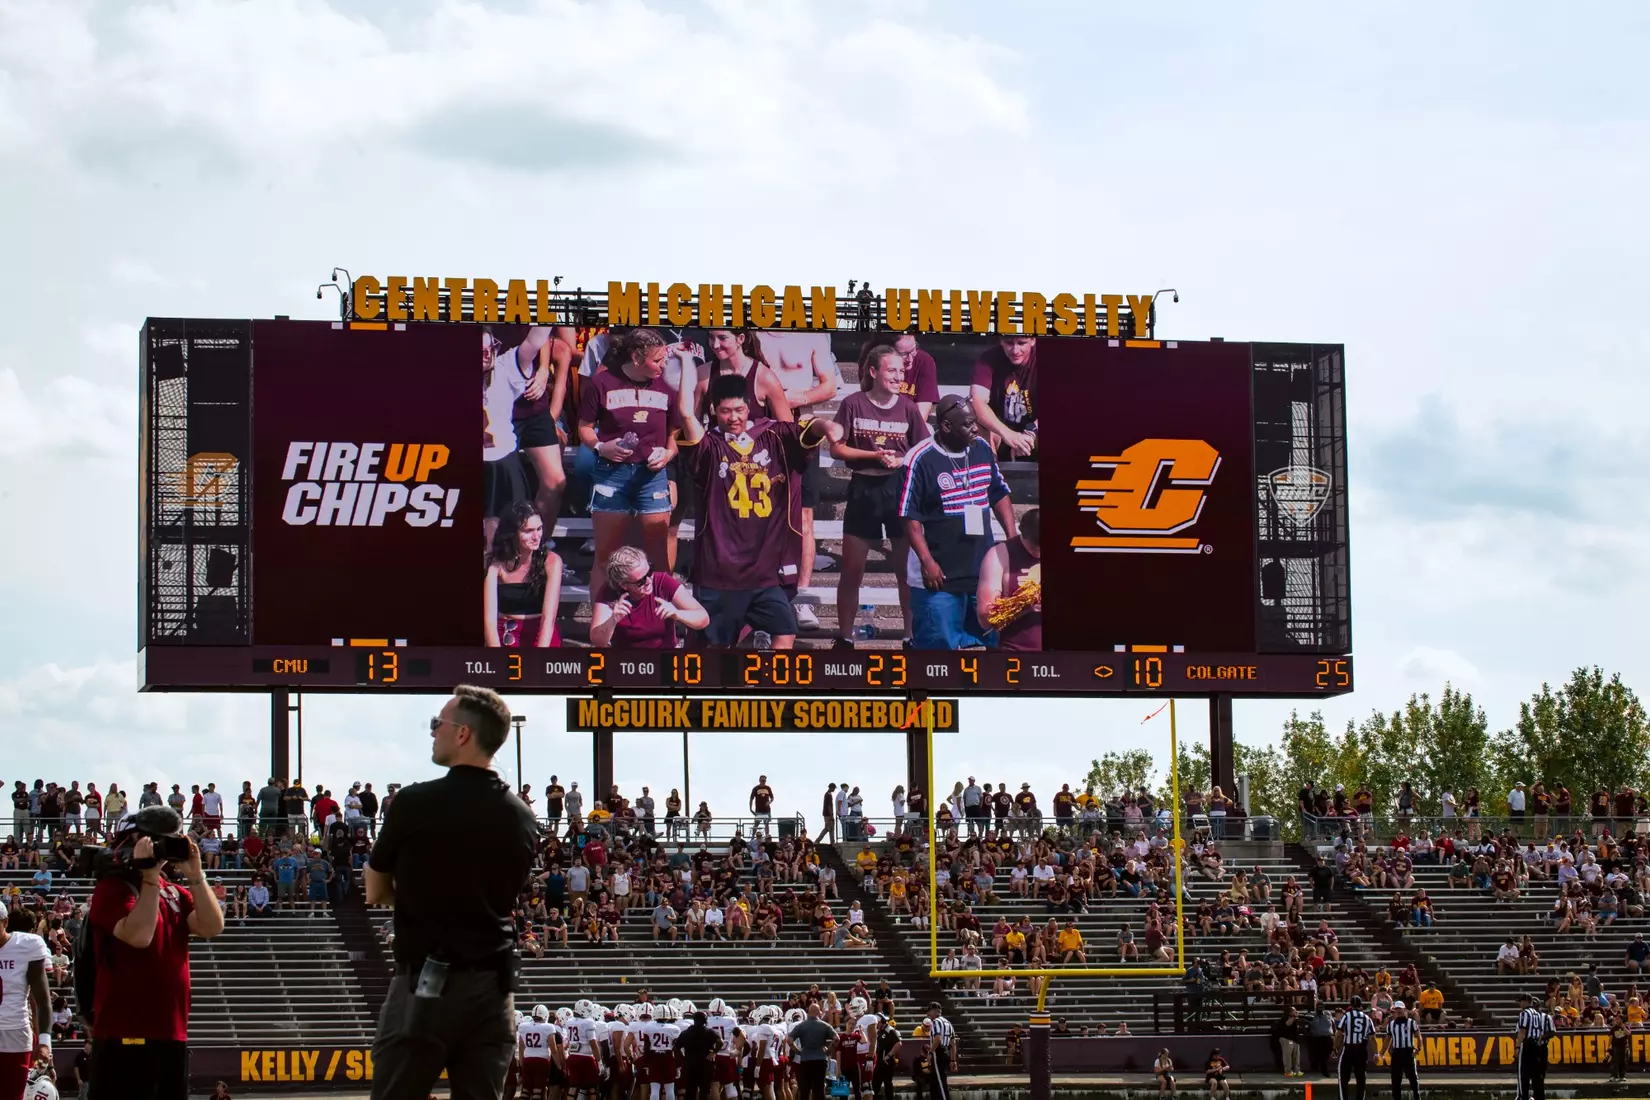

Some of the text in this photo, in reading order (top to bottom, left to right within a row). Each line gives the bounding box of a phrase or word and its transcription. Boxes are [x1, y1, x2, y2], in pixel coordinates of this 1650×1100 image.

[354, 275, 1153, 337] CENTRAL MICHIGAN UNIVERSITY
[281, 441, 385, 481] FIRE
[384, 443, 450, 482] UP
[281, 482, 460, 527] CHIPS!
[728, 472, 772, 518] 43
[273, 659, 308, 673] CMU
[368, 652, 398, 682] 13
[466, 654, 522, 680] T.O.L. 3
[546, 653, 605, 683] DOWN 2
[620, 653, 701, 684] TO GO 10
[744, 654, 813, 684] 2:00
[824, 655, 907, 685] BALL ON 23
[926, 657, 978, 684] QTR 4
[1006, 658, 1060, 683] 2 T.O.L.
[1135, 657, 1162, 687] 10
[1186, 666, 1257, 680] COLGATE
[1316, 661, 1349, 686] 25
[578, 700, 952, 729] McGUIRK FAMILY SCOREBOARD
[525, 1032, 542, 1049] 62
[653, 1032, 669, 1048] 24
[1354, 1018, 1364, 1033] S
[241, 1050, 320, 1081] KELLY
[1376, 1036, 1477, 1066] KAMER
